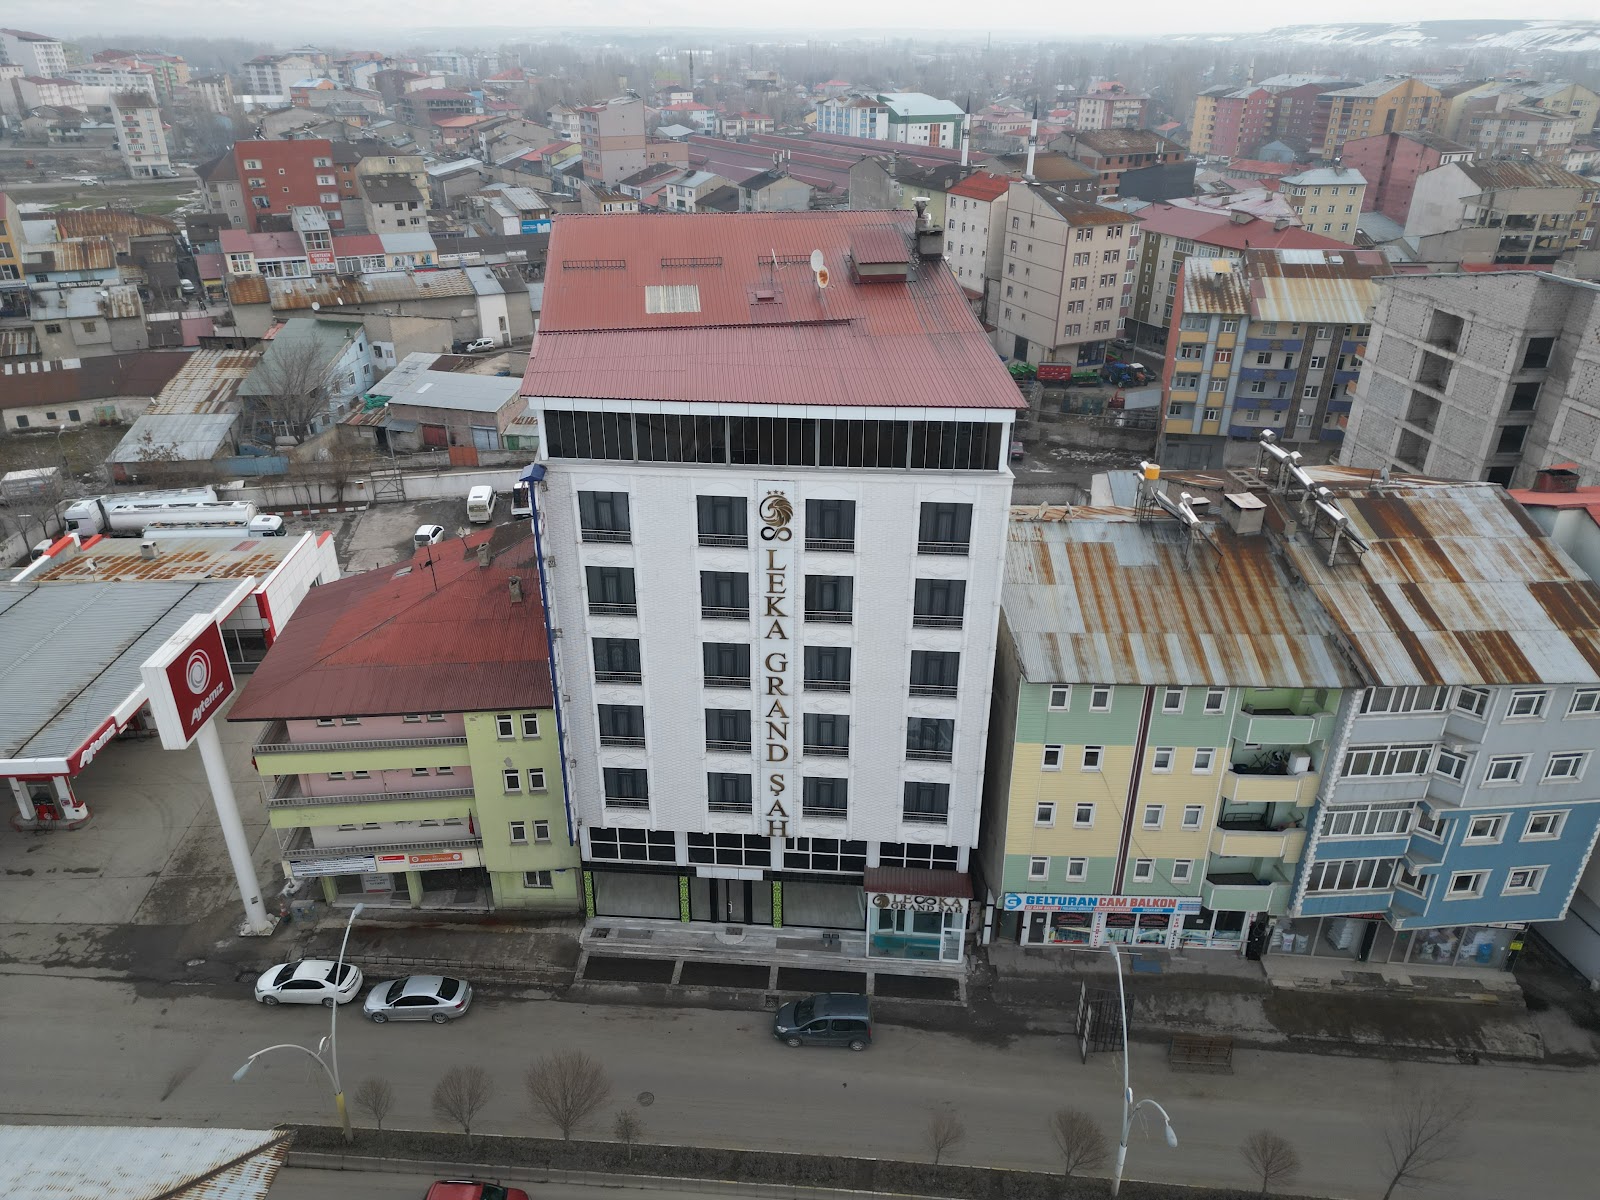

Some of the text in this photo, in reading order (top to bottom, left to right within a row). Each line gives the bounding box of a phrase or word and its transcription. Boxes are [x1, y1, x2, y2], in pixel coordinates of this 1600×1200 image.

[190, 681, 225, 726] Aytemiz
[765, 549, 790, 838] LEKA GRAND ŞAH
[891, 903, 935, 912] GRAND
[1025, 895, 1098, 907] GELTURAN
[1098, 897, 1127, 907] CAM
[1129, 898, 1177, 908] BALKON
